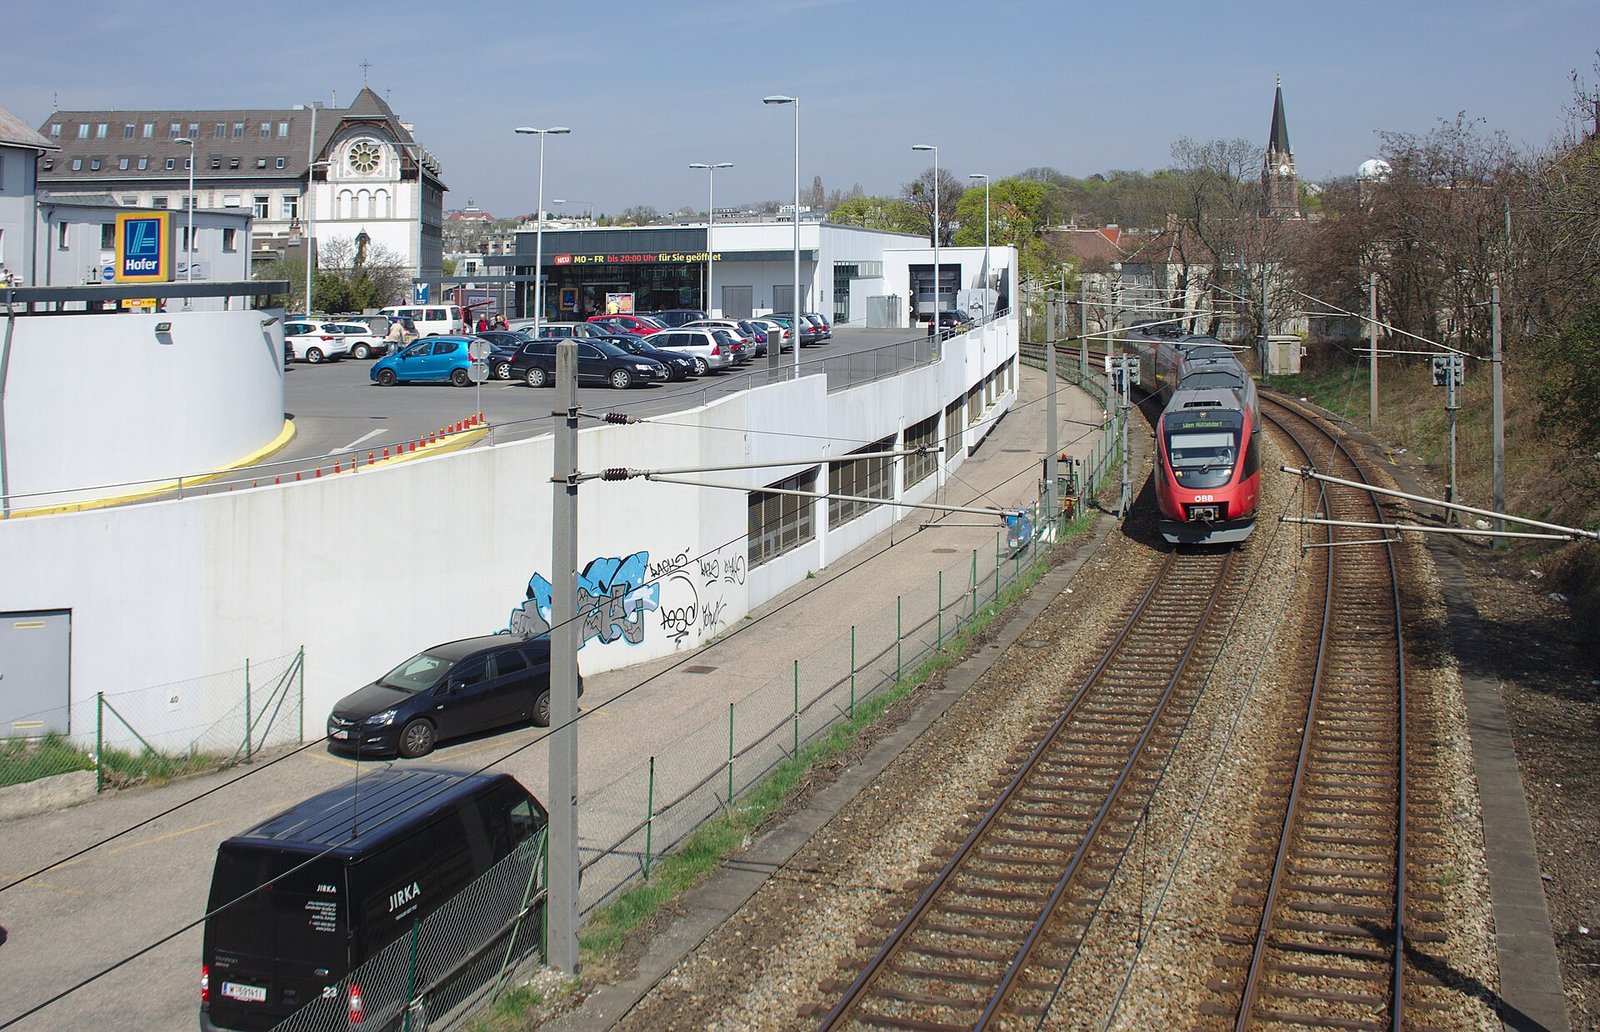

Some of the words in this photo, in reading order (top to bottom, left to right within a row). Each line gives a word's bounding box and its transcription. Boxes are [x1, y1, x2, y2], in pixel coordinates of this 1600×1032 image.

[557, 256, 570, 264] NEU
[573, 255, 587, 263] MO
[594, 255, 605, 263] FR
[607, 254, 619, 262] bis
[620, 254, 642, 262] 20:00
[643, 253, 657, 262] Uhr
[658, 253, 671, 262] für
[672, 252, 685, 261] Sie
[125, 258, 158, 271] Hofer
[316, 883, 337, 894] JIRKA
[388, 881, 421, 913] JIRKA
